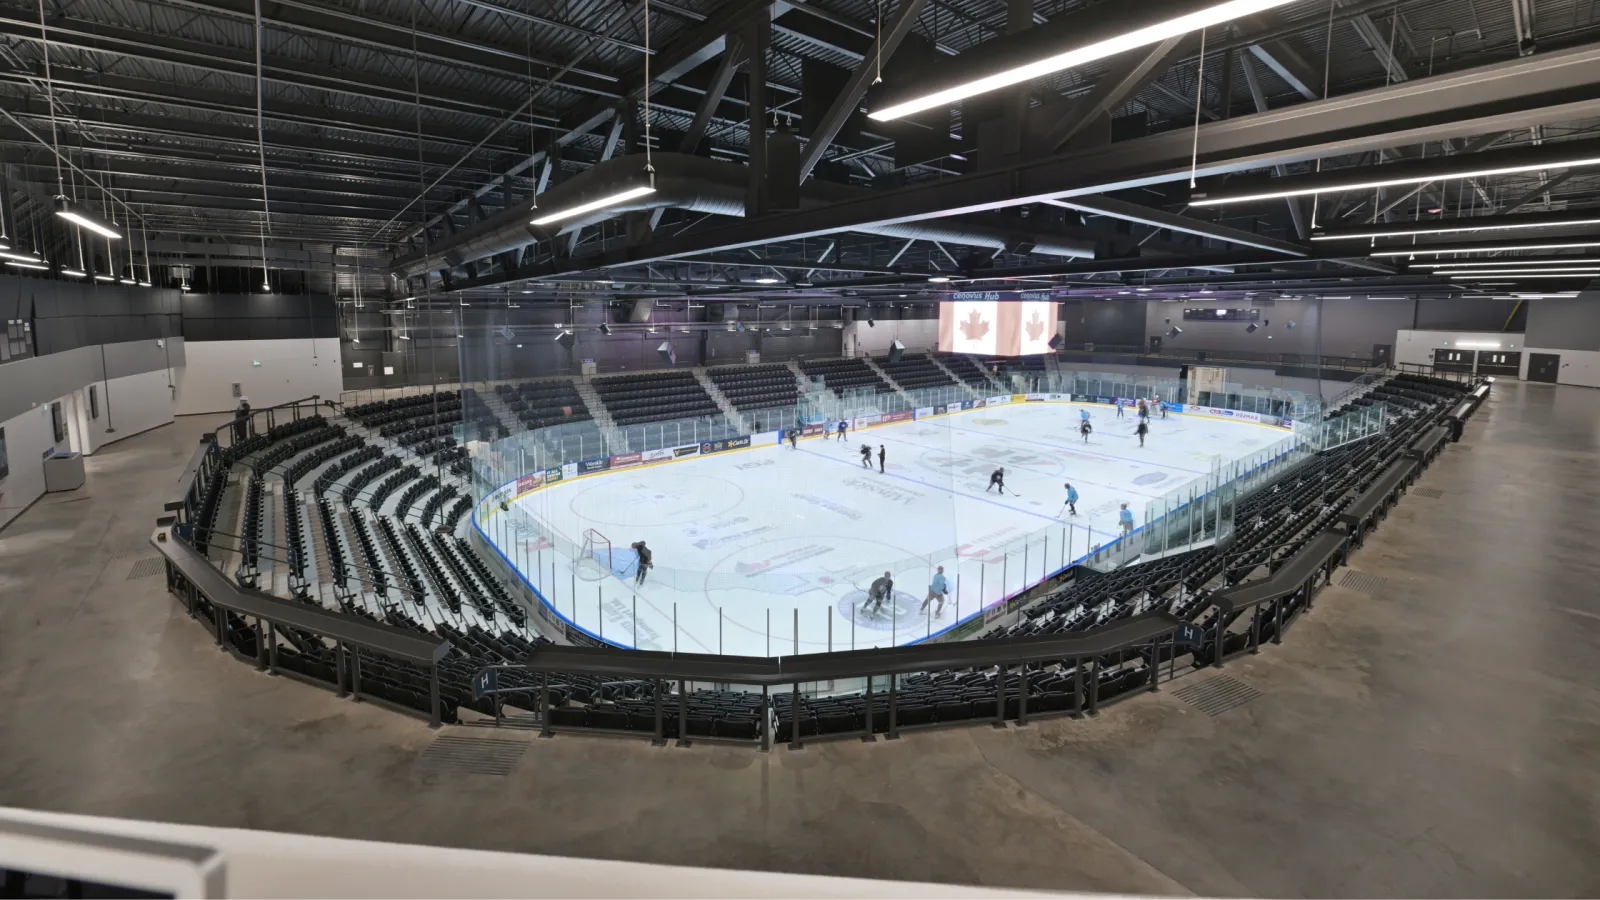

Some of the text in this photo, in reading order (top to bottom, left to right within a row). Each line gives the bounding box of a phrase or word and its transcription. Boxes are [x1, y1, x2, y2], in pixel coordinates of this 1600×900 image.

[984, 291, 1000, 300] Hub
[1235, 412, 1259, 420] RE/MAX
[1184, 626, 1193, 639] H
[481, 673, 488, 688] H
